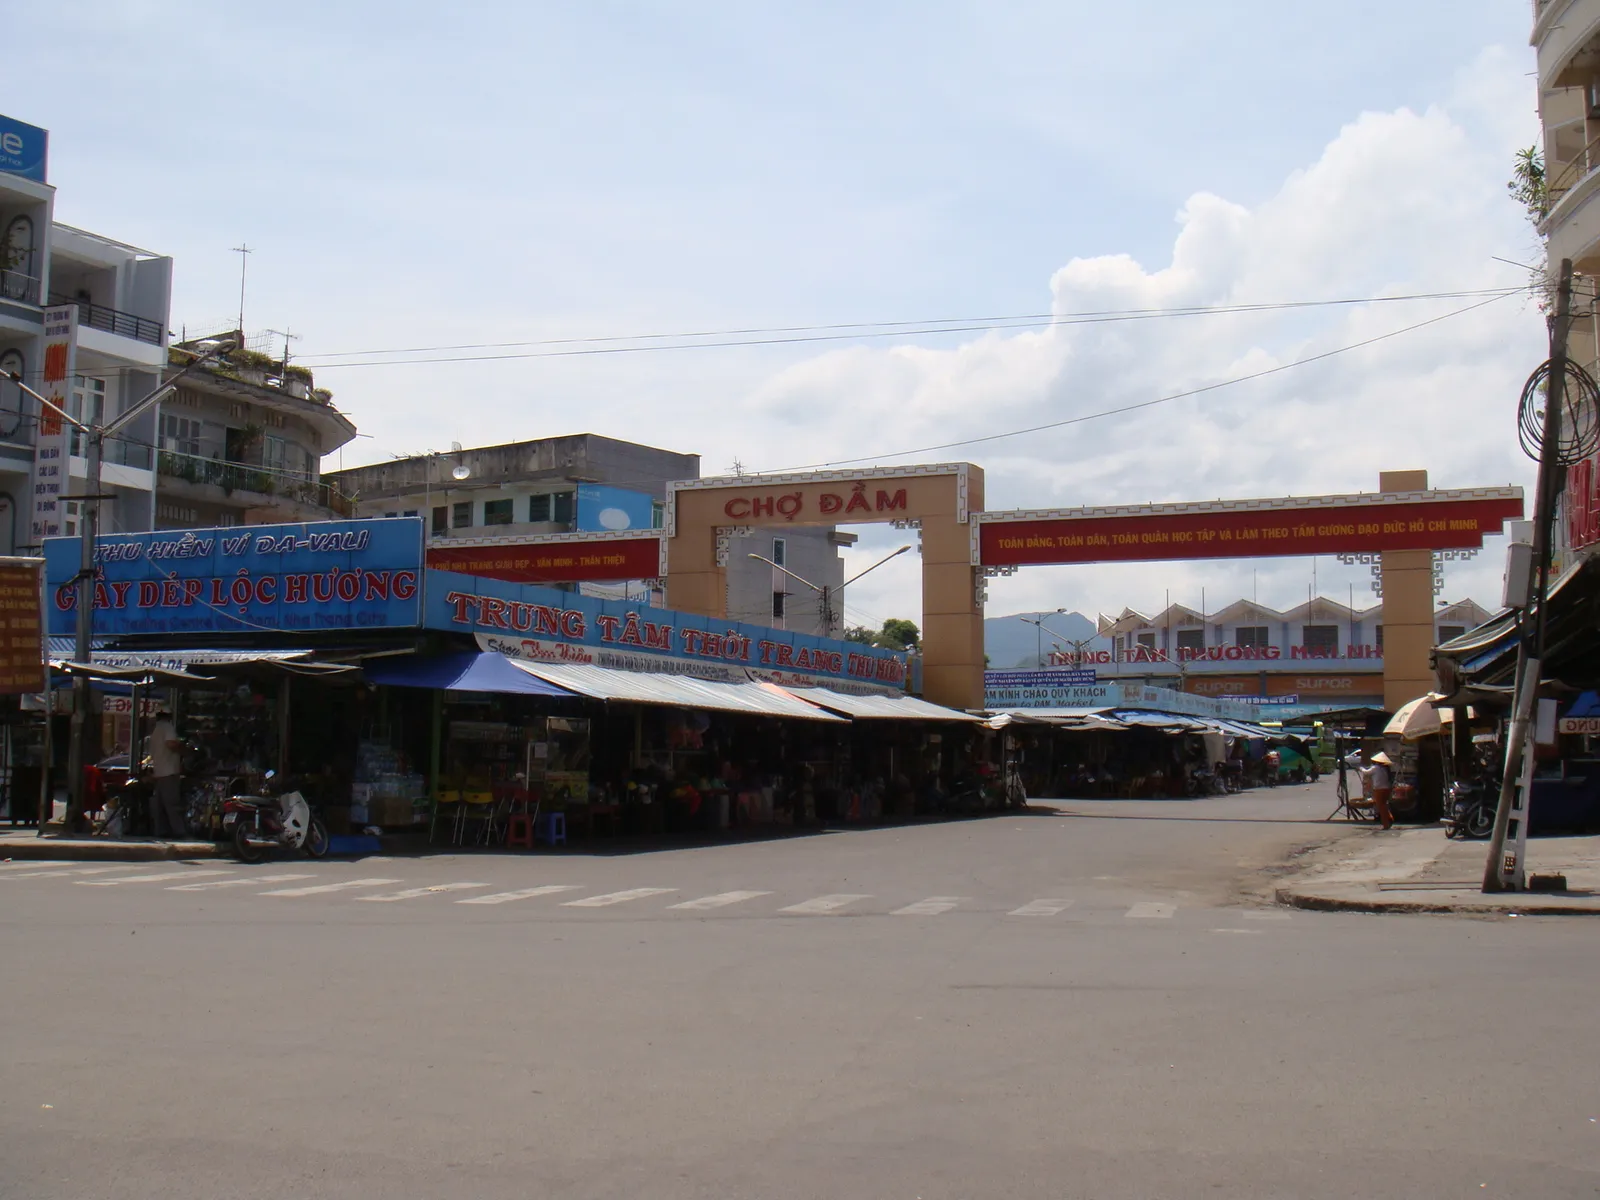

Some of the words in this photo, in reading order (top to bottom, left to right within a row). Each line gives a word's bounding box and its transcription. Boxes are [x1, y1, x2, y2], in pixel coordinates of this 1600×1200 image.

[724, 491, 803, 520] CHỢ
[819, 480, 907, 515] ĐẦM
[93, 542, 143, 562] THU
[147, 532, 215, 560] HIỀN
[221, 532, 252, 557] VÍ
[998, 537, 1024, 549] TOÀN
[1058, 534, 1084, 546] TOÀN
[1112, 533, 1139, 545] TOÀN
[1141, 532, 1170, 545] QUÂN
[1172, 531, 1193, 545] HỌC
[1196, 528, 1216, 545] TẬP
[1219, 527, 1232, 541] VÀ
[1236, 526, 1259, 541] LÀM
[1261, 527, 1290, 539] THEO
[1292, 523, 1315, 538] TẤM
[1318, 523, 1355, 537] GƯƠNG
[1358, 522, 1380, 537] ĐẠO
[1383, 519, 1406, 533] ĐỨC
[1409, 518, 1425, 533] HỒ
[1428, 517, 1447, 532] CHÍ
[1449, 518, 1478, 531] MINH
[553, 557, 573, 567] MINH
[55, 564, 132, 611] GẦY
[137, 571, 203, 608] DÉP
[210, 567, 277, 614] LỘC
[283, 566, 417, 604] HƯƠNG
[446, 591, 588, 639] TRUNG
[596, 611, 674, 650] TÂM
[680, 627, 752, 660] THỜI
[758, 640, 843, 674] TRANG
[847, 652, 874, 678] THU
[1347, 644, 1385, 659] NH
[1194, 681, 1245, 693] SUPOR
[1295, 678, 1353, 690] SUPOR
